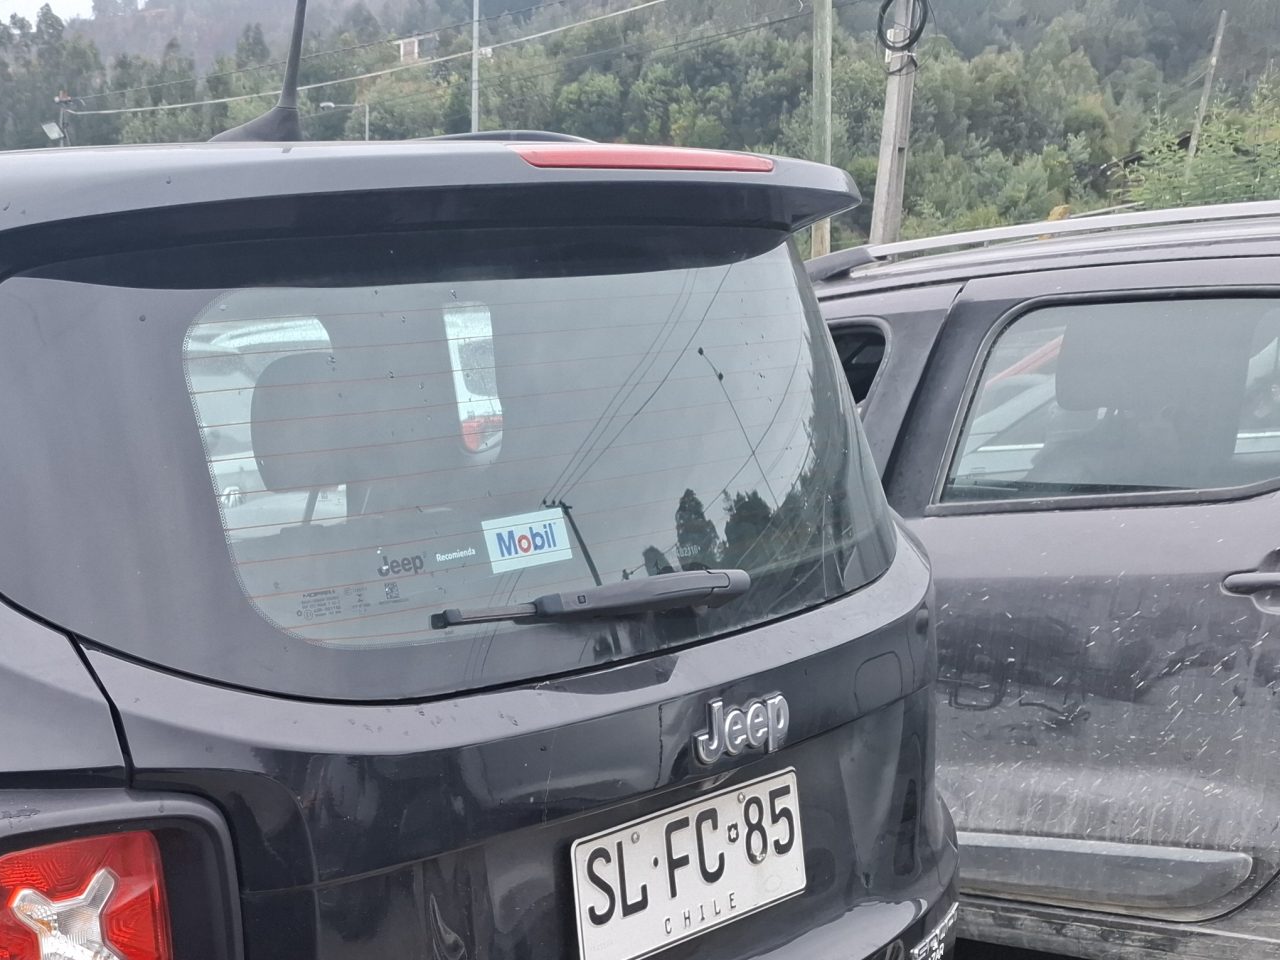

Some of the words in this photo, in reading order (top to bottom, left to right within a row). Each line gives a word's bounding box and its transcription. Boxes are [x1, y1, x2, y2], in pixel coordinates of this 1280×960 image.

[377, 555, 424, 577] Jeep
[436, 547, 476, 562] Recomienda
[495, 522, 557, 557] Mobil
[692, 692, 789, 765] Jeep
[664, 892, 737, 935] CHILE
